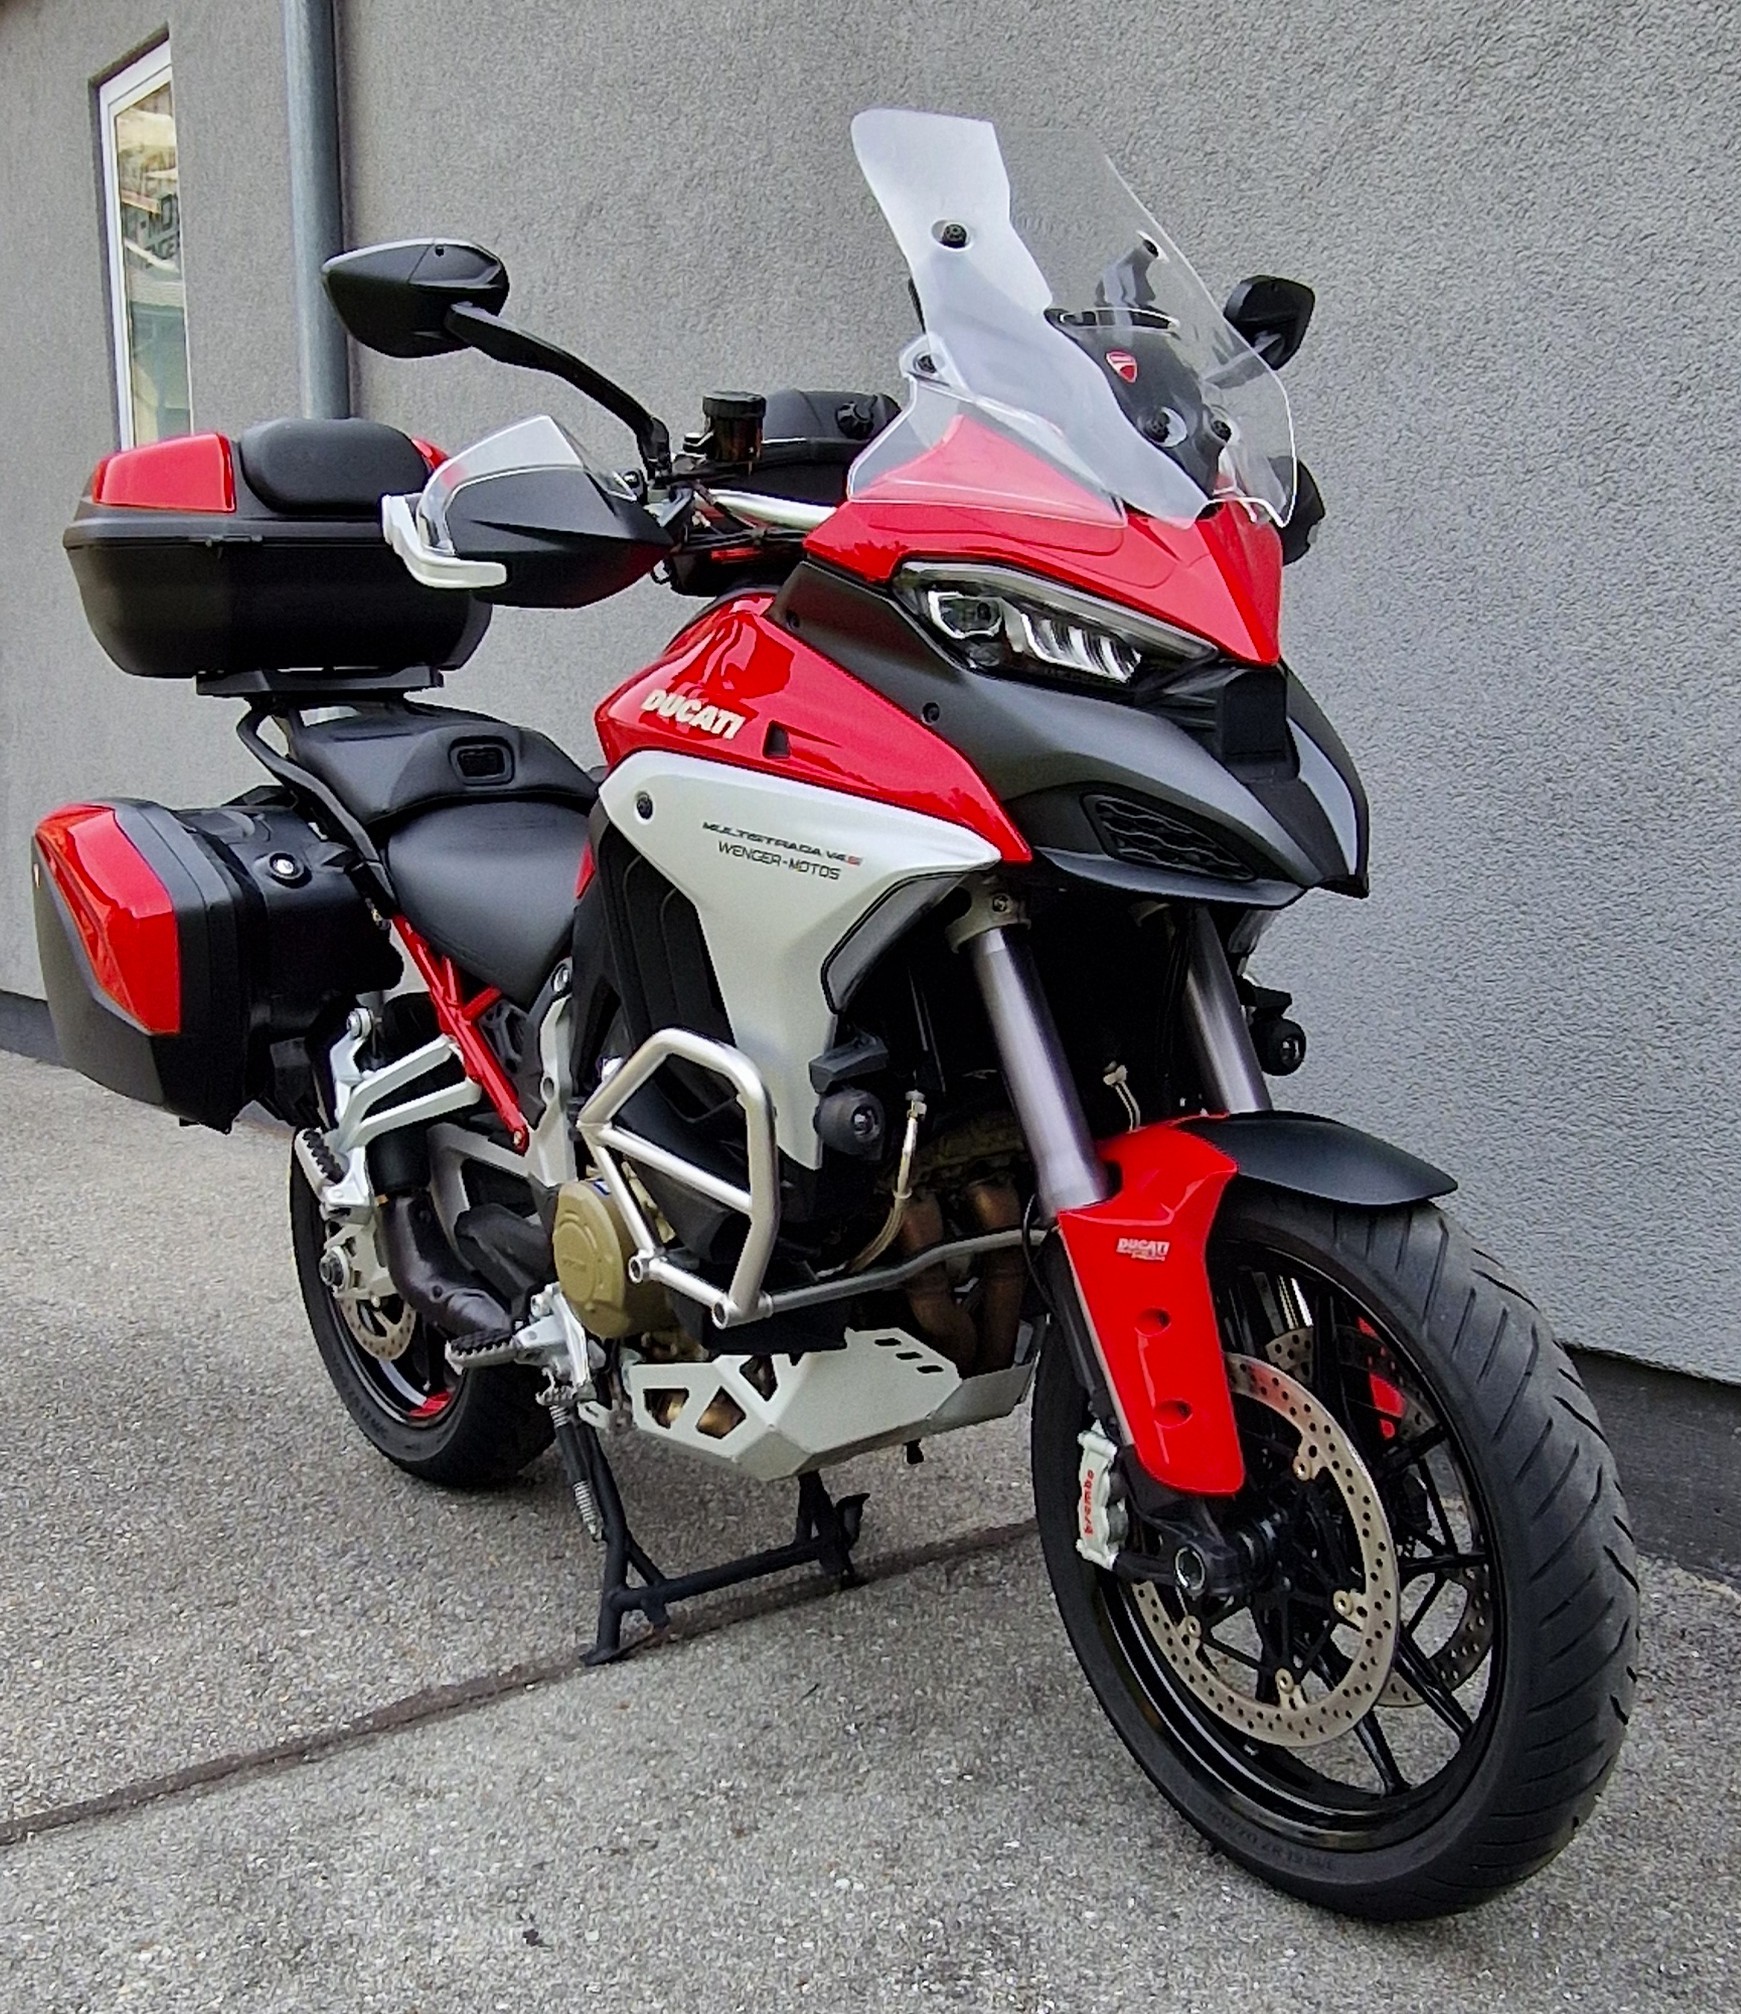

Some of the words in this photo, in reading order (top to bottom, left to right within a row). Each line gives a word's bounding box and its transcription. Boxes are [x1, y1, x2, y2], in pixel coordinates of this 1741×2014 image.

[641, 689, 746, 739] DUCATI
[702, 821, 822, 857] MULTISTRADA
[718, 840, 841, 881] WENGER-MOTOS
[1116, 1238, 1170, 1256] DUCATI
